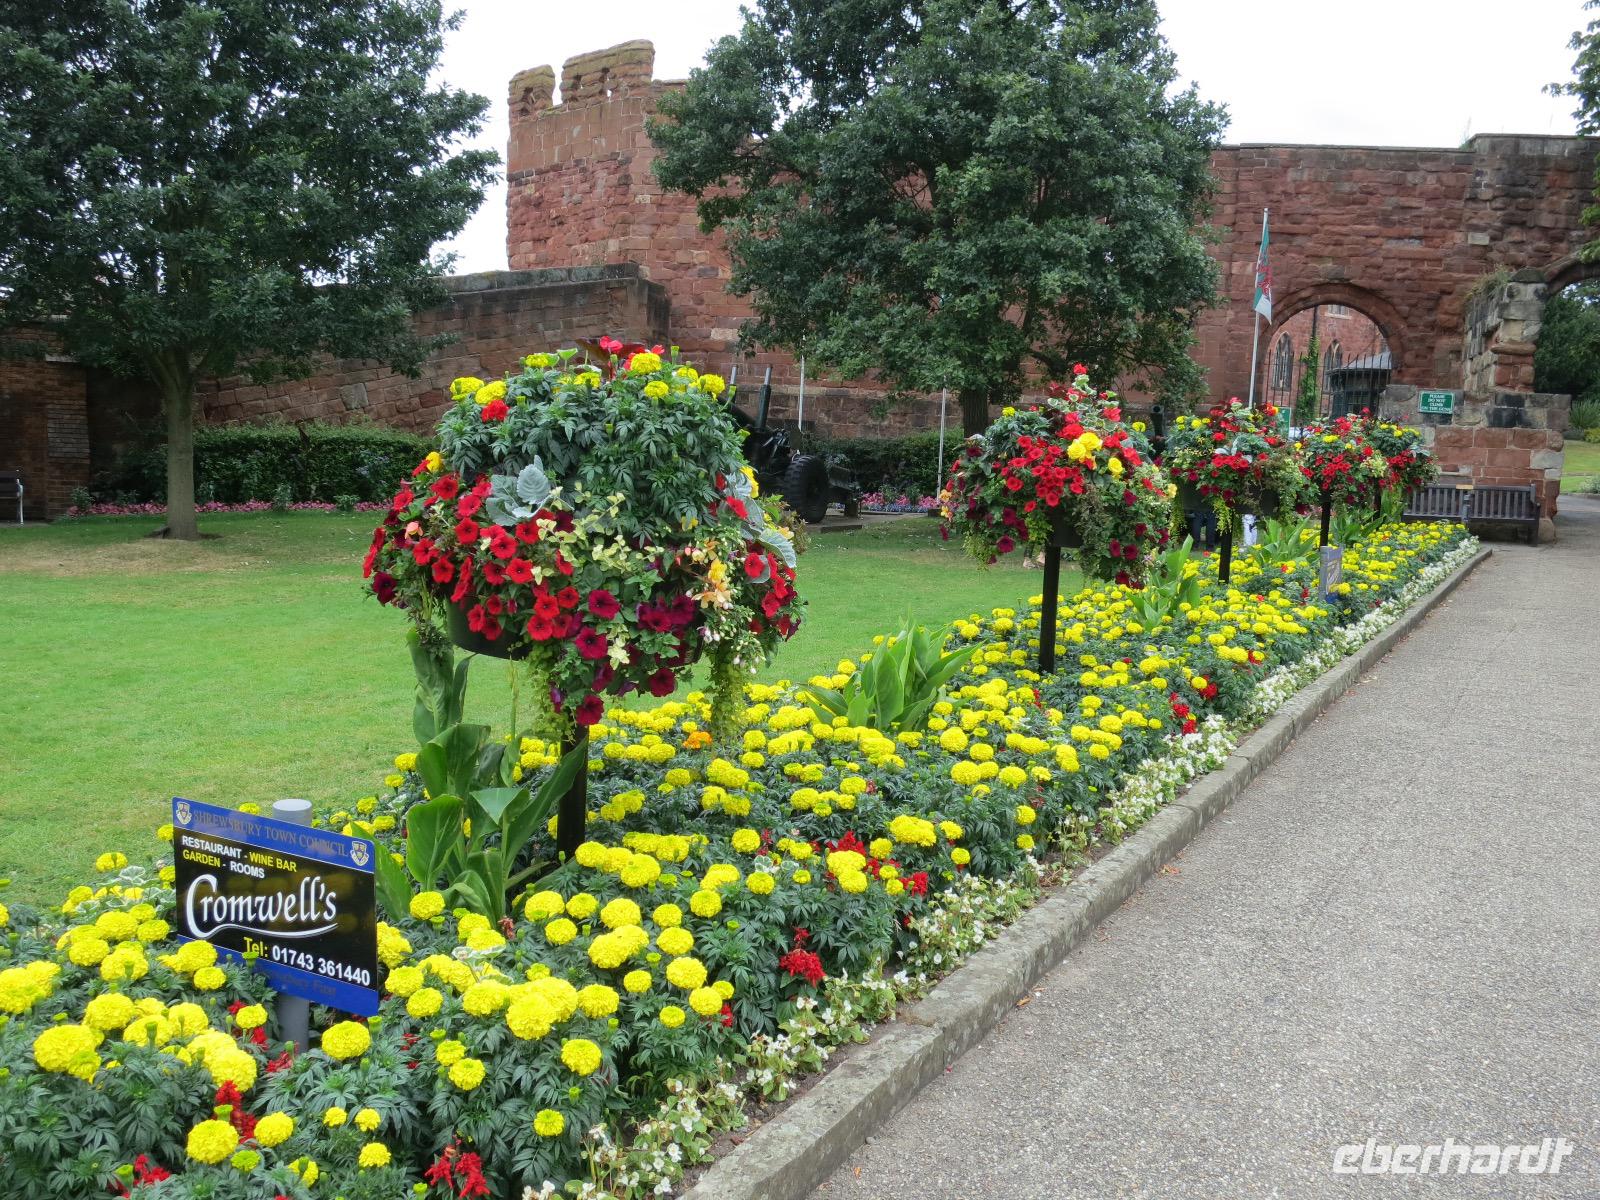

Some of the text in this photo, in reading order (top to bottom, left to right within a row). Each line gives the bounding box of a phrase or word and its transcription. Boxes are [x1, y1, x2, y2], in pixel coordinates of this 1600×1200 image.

[182, 836, 242, 860] RESTAURANT
[249, 852, 274, 867] WINE
[276, 858, 297, 872] BAR
[194, 810, 348, 857] SHREWSBURY TOWN COUNCIL
[182, 849, 220, 868] GARDEN
[230, 860, 265, 879] ROOMS
[186, 874, 338, 938] Cromwell's
[244, 936, 268, 958] Tel:
[272, 945, 314, 971] 01743
[318, 956, 370, 986] 361440
